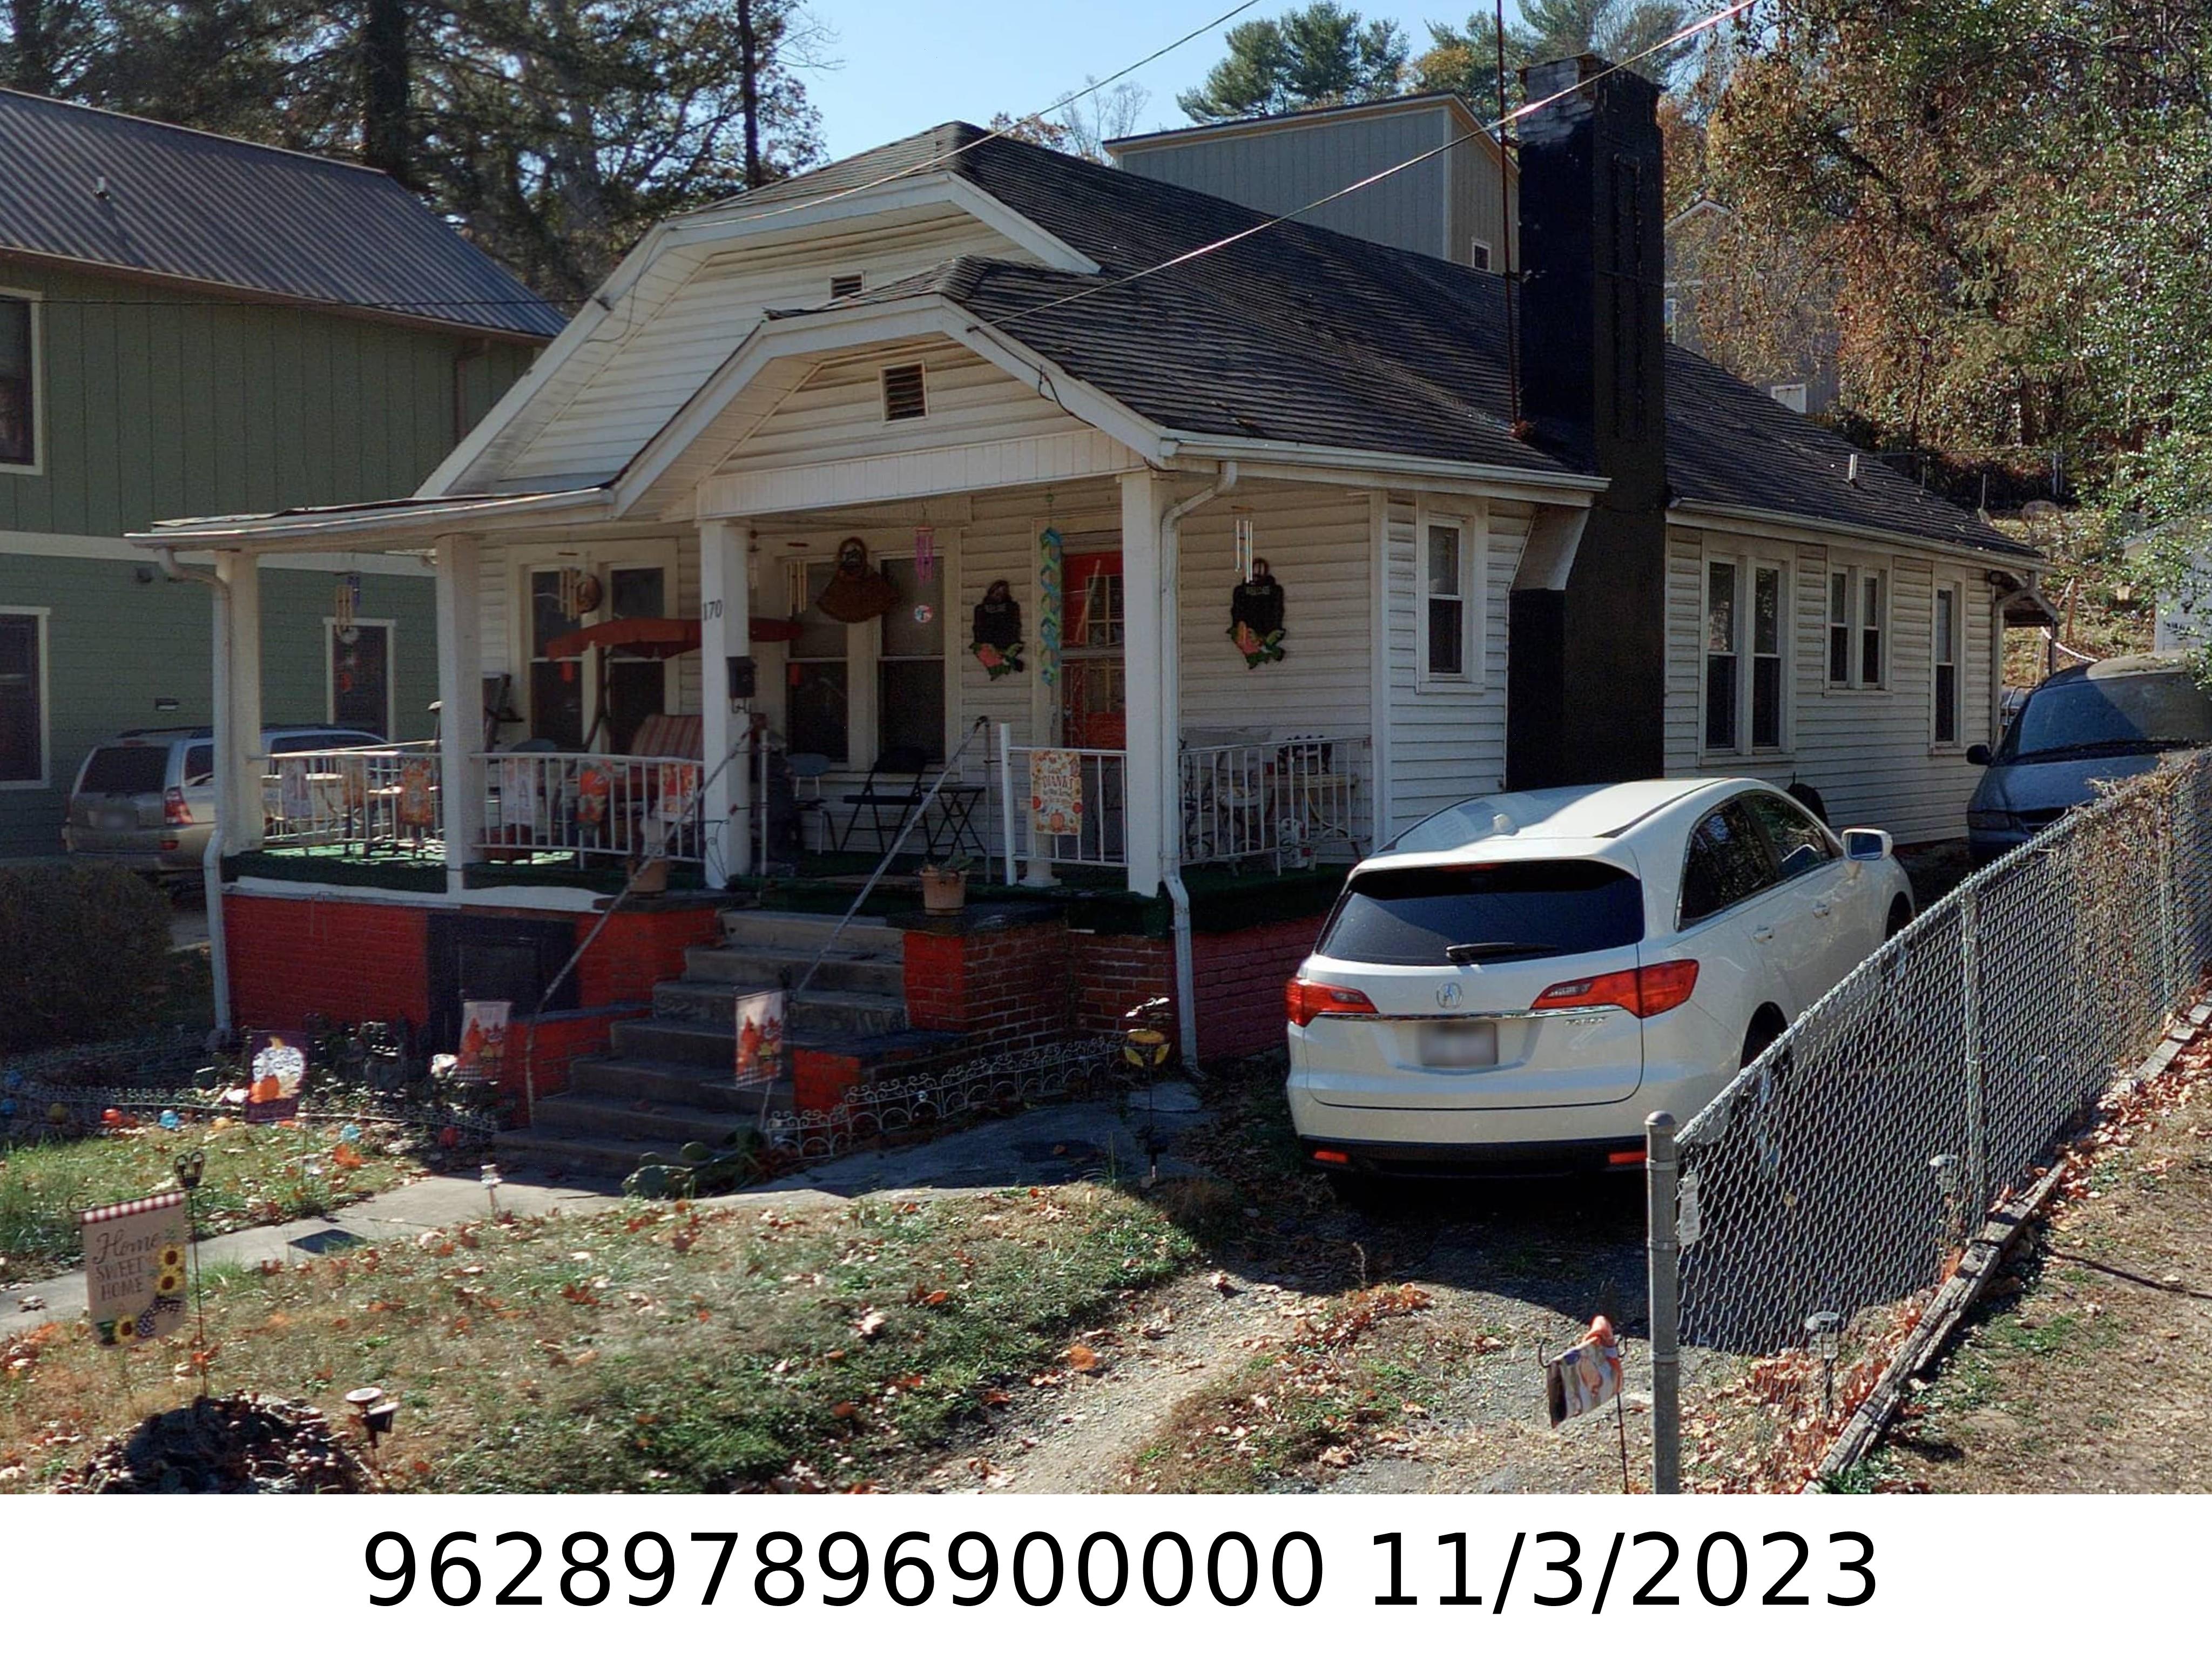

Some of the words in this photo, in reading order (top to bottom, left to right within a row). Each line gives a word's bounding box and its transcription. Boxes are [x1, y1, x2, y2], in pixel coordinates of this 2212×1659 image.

[704, 599, 723, 621] 170
[94, 1229, 161, 1264] Home
[96, 1258, 143, 1281] SWEET
[101, 1277, 144, 1300] HOME
